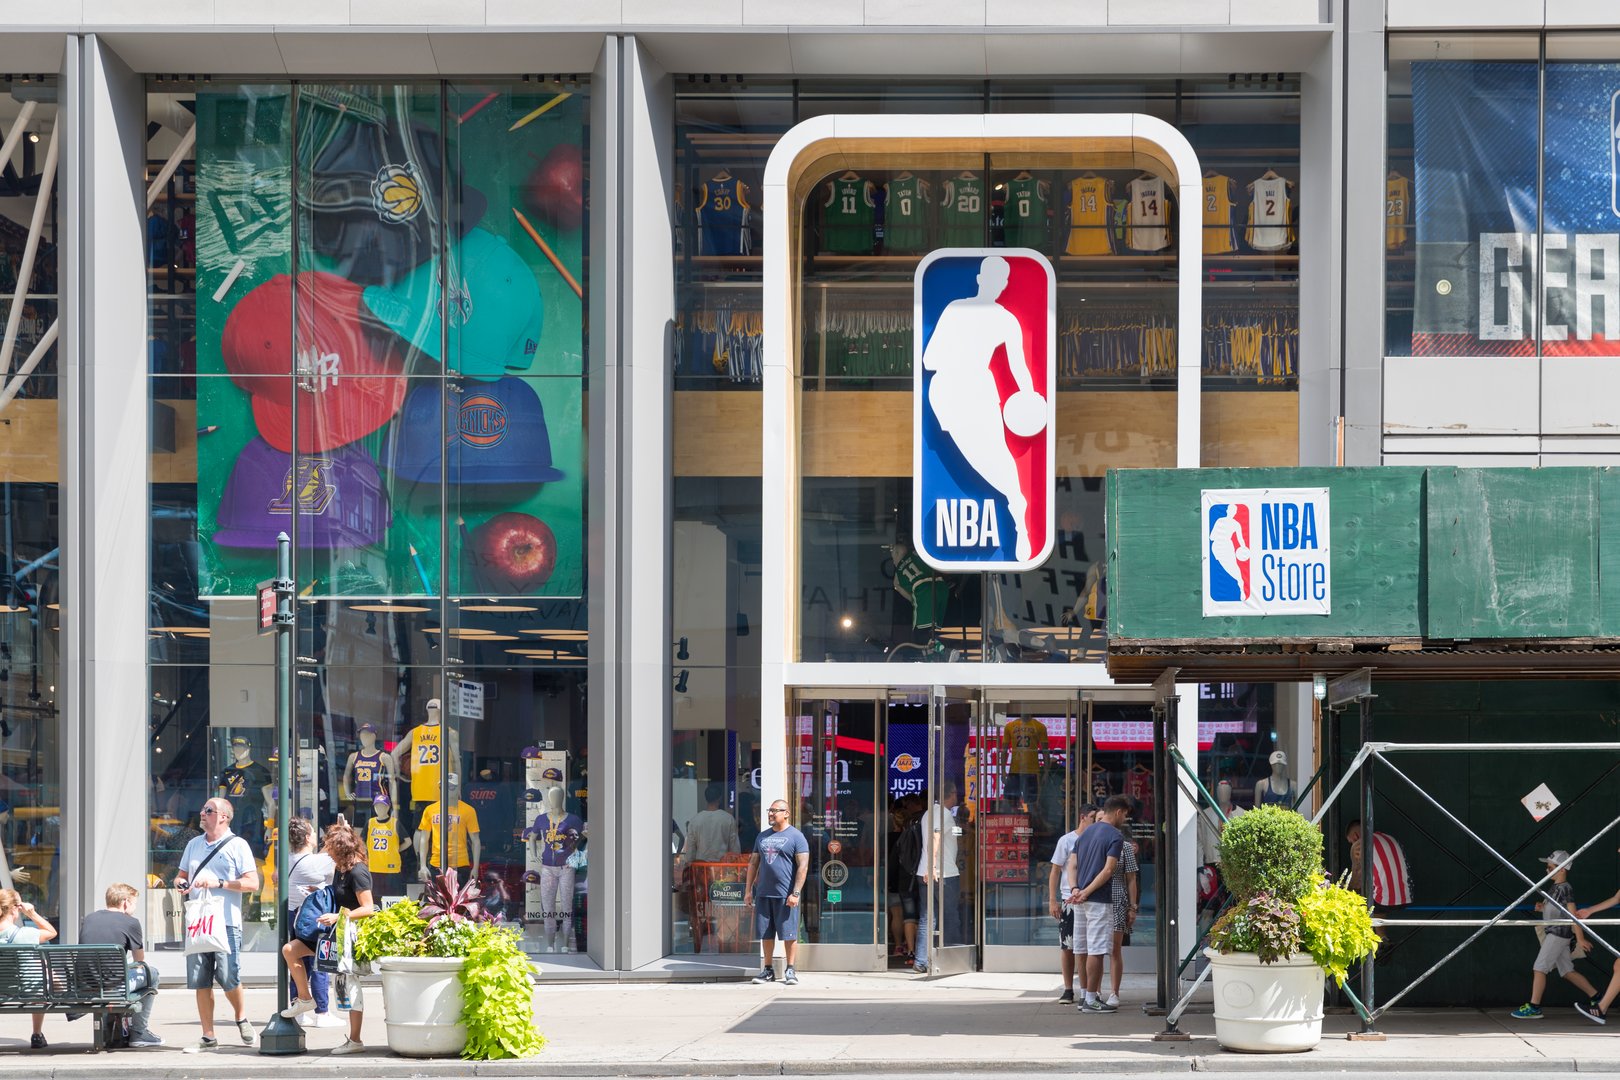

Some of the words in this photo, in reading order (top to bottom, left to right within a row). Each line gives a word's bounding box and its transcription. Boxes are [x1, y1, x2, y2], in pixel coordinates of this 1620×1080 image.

[714, 197, 731, 211] 30
[842, 196, 856, 214] 11
[901, 198, 911, 215] 0
[958, 195, 980, 213] 20
[1019, 199, 1030, 217] 0
[1081, 194, 1097, 213] 14
[1141, 199, 1158, 217] 14
[1206, 194, 1217, 212] 2
[1265, 200, 1276, 216] 2
[1387, 199, 1403, 217] 23
[460, 409, 503, 433] KNICKS
[936, 499, 1000, 547] NBA
[1261, 503, 1318, 550] NBA
[903, 562, 923, 582] 11
[1262, 554, 1325, 601] Store
[420, 734, 438, 742] JAMES
[1016, 735, 1031, 749] 23
[418, 745, 440, 765] 23
[357, 768, 372, 782] 23
[890, 779, 924, 790] JUST
[373, 838, 388, 850] 23
[713, 889, 742, 899] SPALDING
